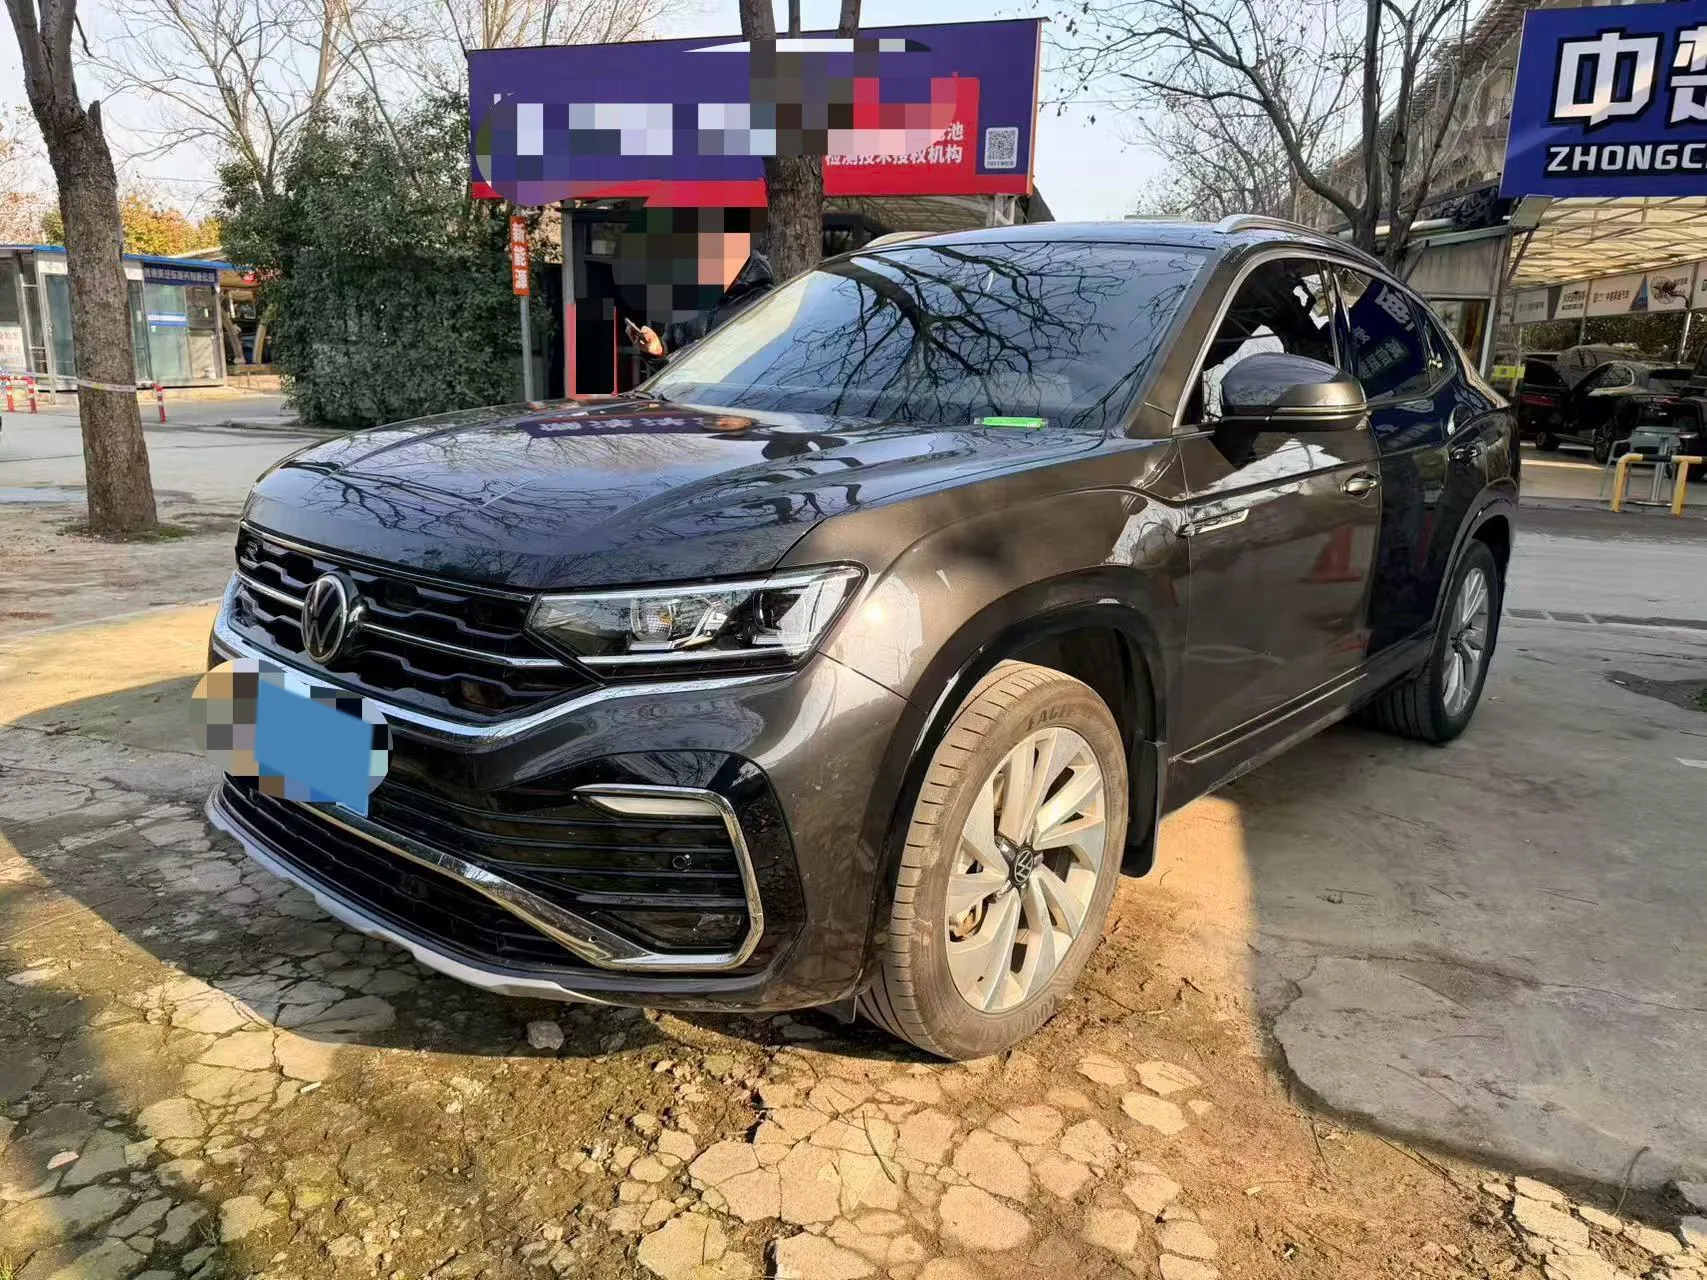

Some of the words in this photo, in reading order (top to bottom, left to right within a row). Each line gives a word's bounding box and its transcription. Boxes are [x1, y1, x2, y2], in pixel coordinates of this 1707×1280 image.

[1547, 143, 1707, 171] ZHONGC
[512, 222, 528, 289] 新能源
